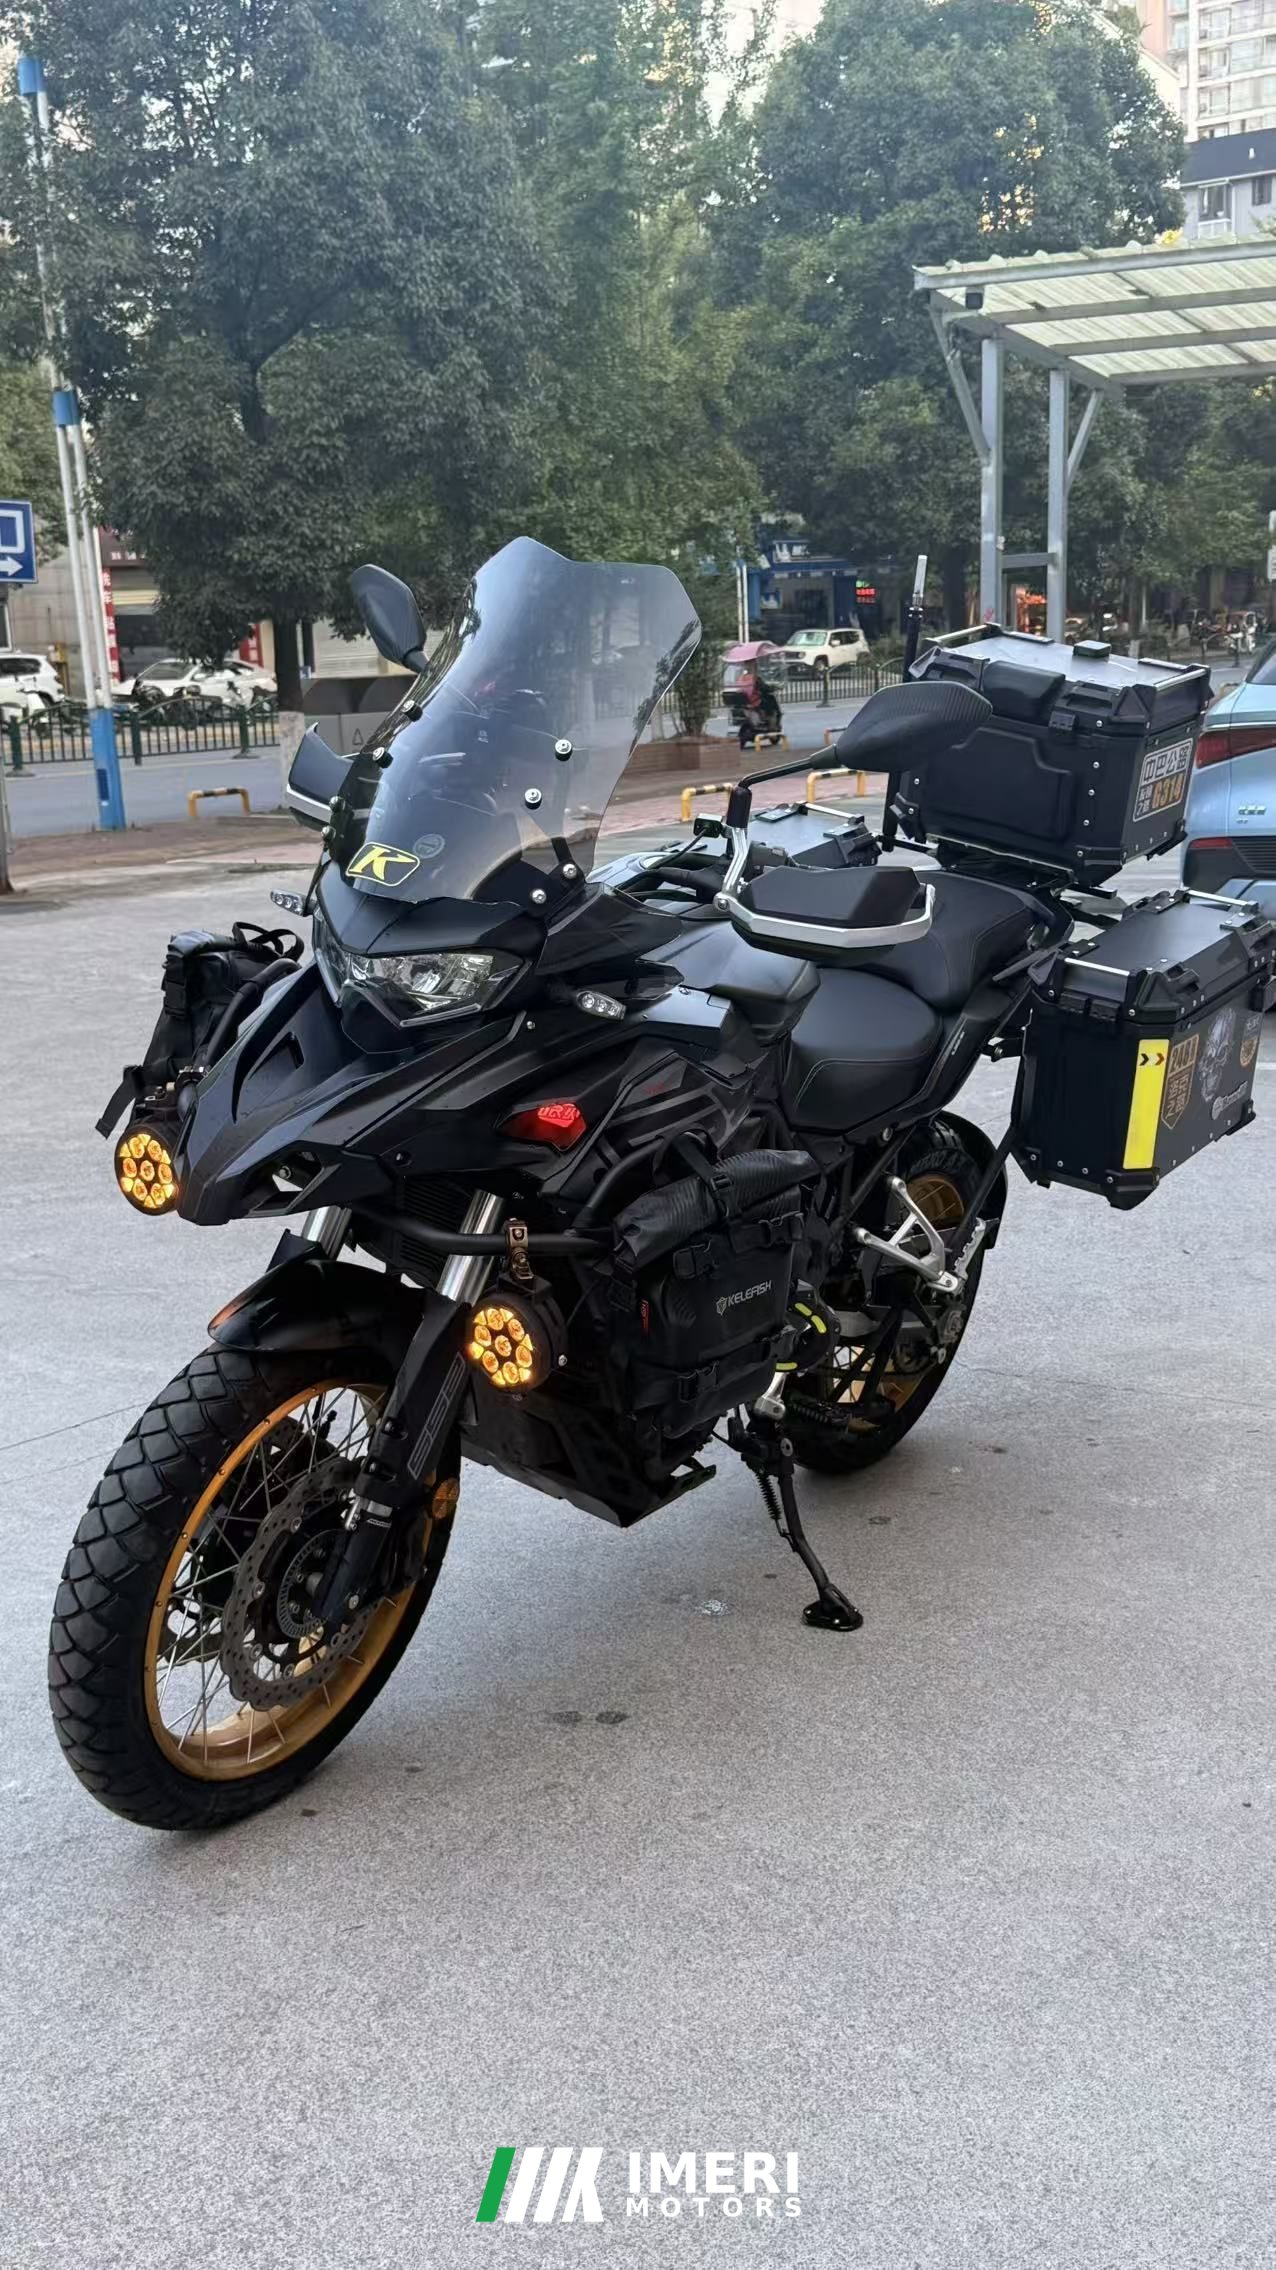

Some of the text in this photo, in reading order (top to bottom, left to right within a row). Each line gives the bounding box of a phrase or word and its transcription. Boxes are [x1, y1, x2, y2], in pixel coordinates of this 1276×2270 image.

[1142, 743, 1190, 783] 中巴公路
[1151, 772, 1184, 809] G314
